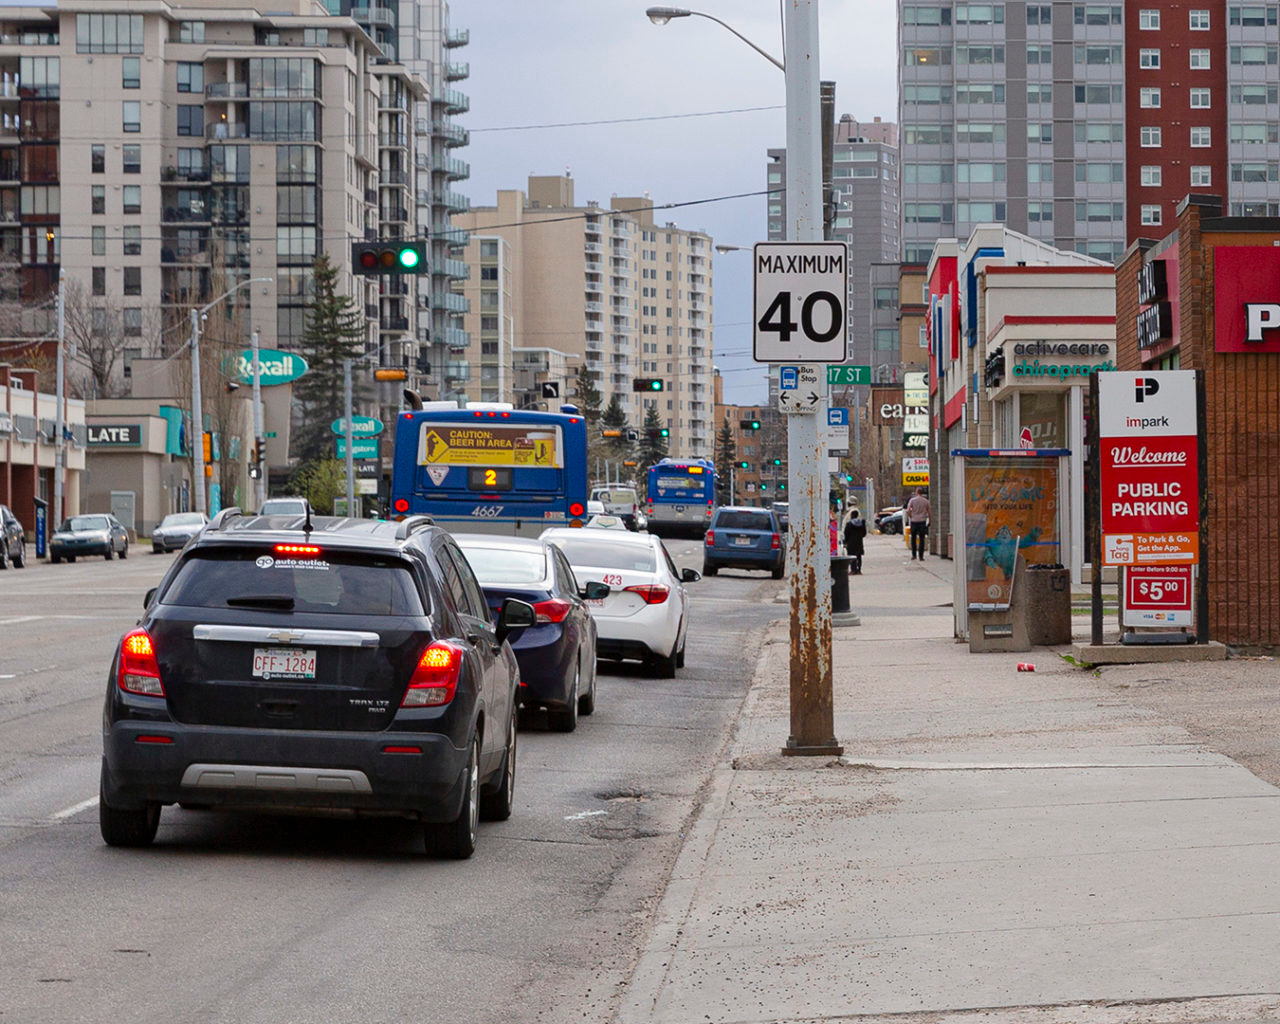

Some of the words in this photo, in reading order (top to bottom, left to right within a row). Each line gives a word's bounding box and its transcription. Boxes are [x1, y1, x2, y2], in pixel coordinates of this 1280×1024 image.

[758, 255, 843, 274] MAXIMUM
[758, 290, 843, 343] 40
[1014, 340, 1110, 355] activecare
[801, 375, 817, 384] Stop
[846, 368, 861, 382] ST
[1126, 416, 1169, 429] impark
[88, 428, 130, 442] LATE
[449, 430, 493, 439] CAUTION:
[449, 439, 474, 447] BEER
[487, 440, 513, 448] AREA
[1110, 446, 1187, 464] Welcome
[485, 469, 497, 485] 2
[1117, 482, 1181, 497] PUBLIC
[472, 506, 504, 516] 4667
[1111, 501, 1188, 517] PARKING
[1149, 535, 1166, 543] Park
[1168, 535, 1175, 543] &
[1176, 535, 1191, 543] Go,
[1110, 550, 1130, 561] Tag
[602, 574, 622, 585] 423
[254, 656, 315, 673] CFF-1284
